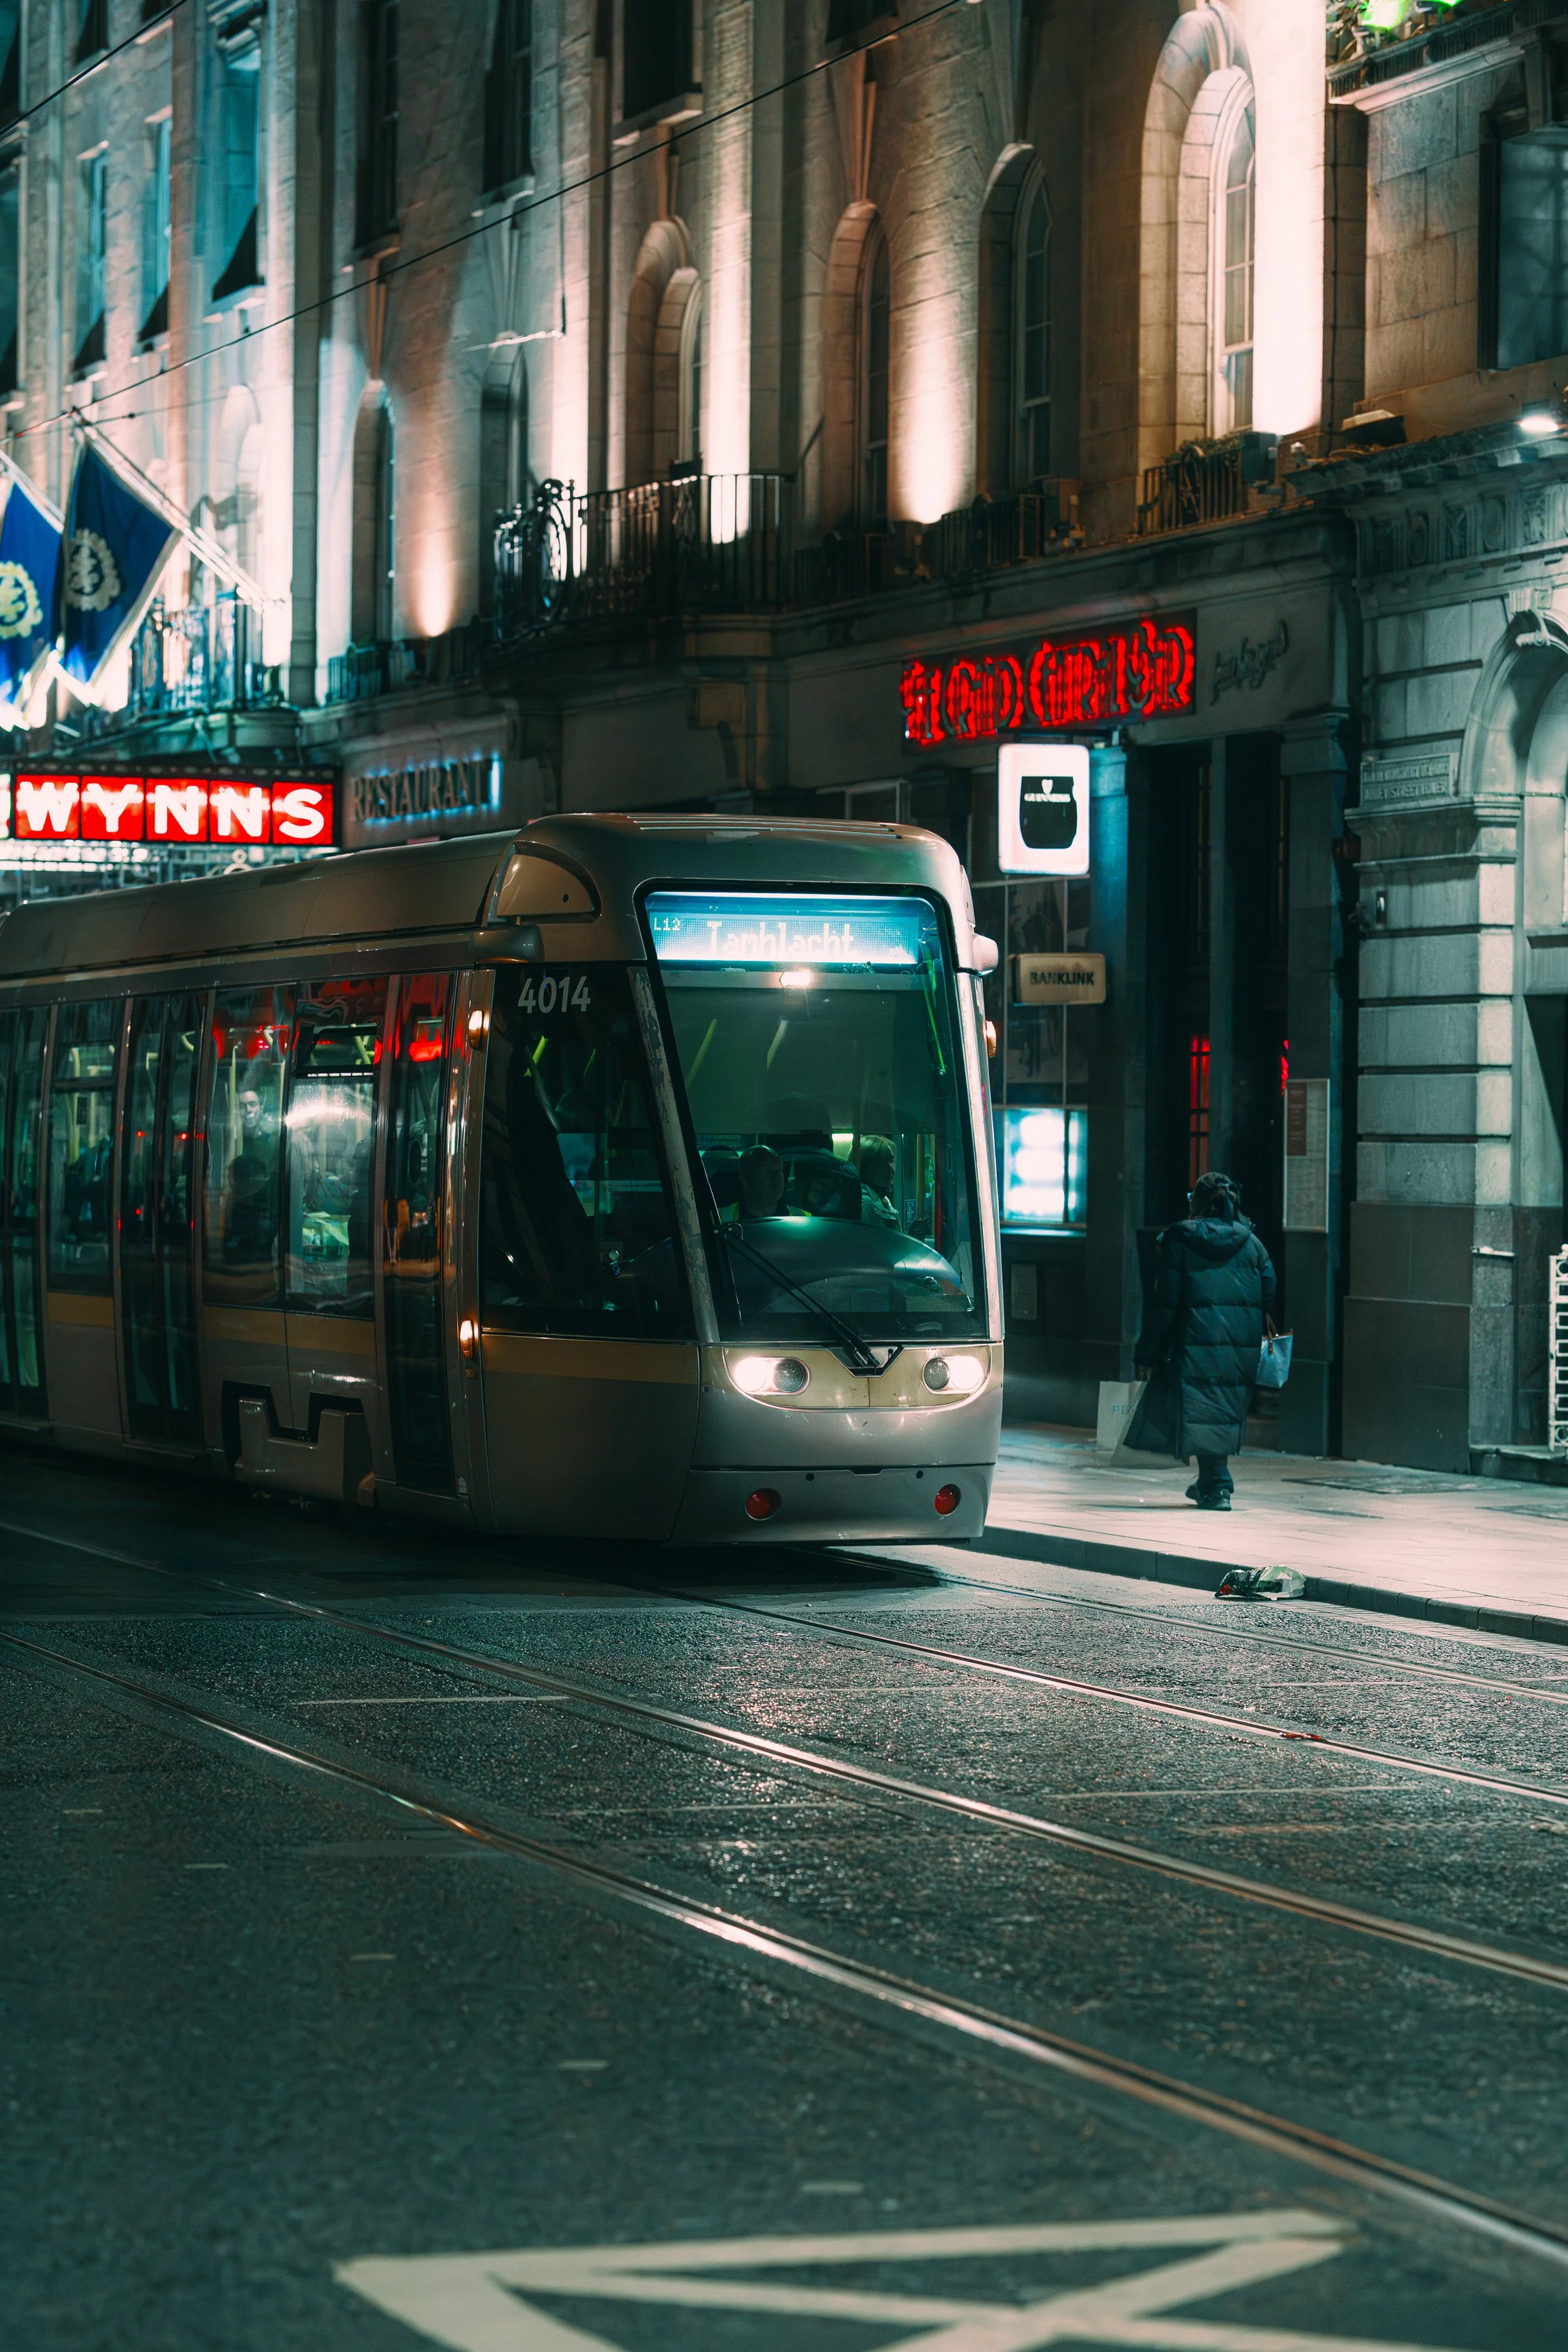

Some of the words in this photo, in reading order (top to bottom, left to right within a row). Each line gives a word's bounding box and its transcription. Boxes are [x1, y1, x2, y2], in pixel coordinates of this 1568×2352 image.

[351, 758, 495, 822] RESTAURANT
[1024, 793, 1071, 803] GUINNESS
[19, 781, 325, 839] WYNNS
[706, 920, 857, 960] Tamhlacht
[518, 975, 591, 1014] 4014
[1029, 971, 1094, 986] BANKLINK
